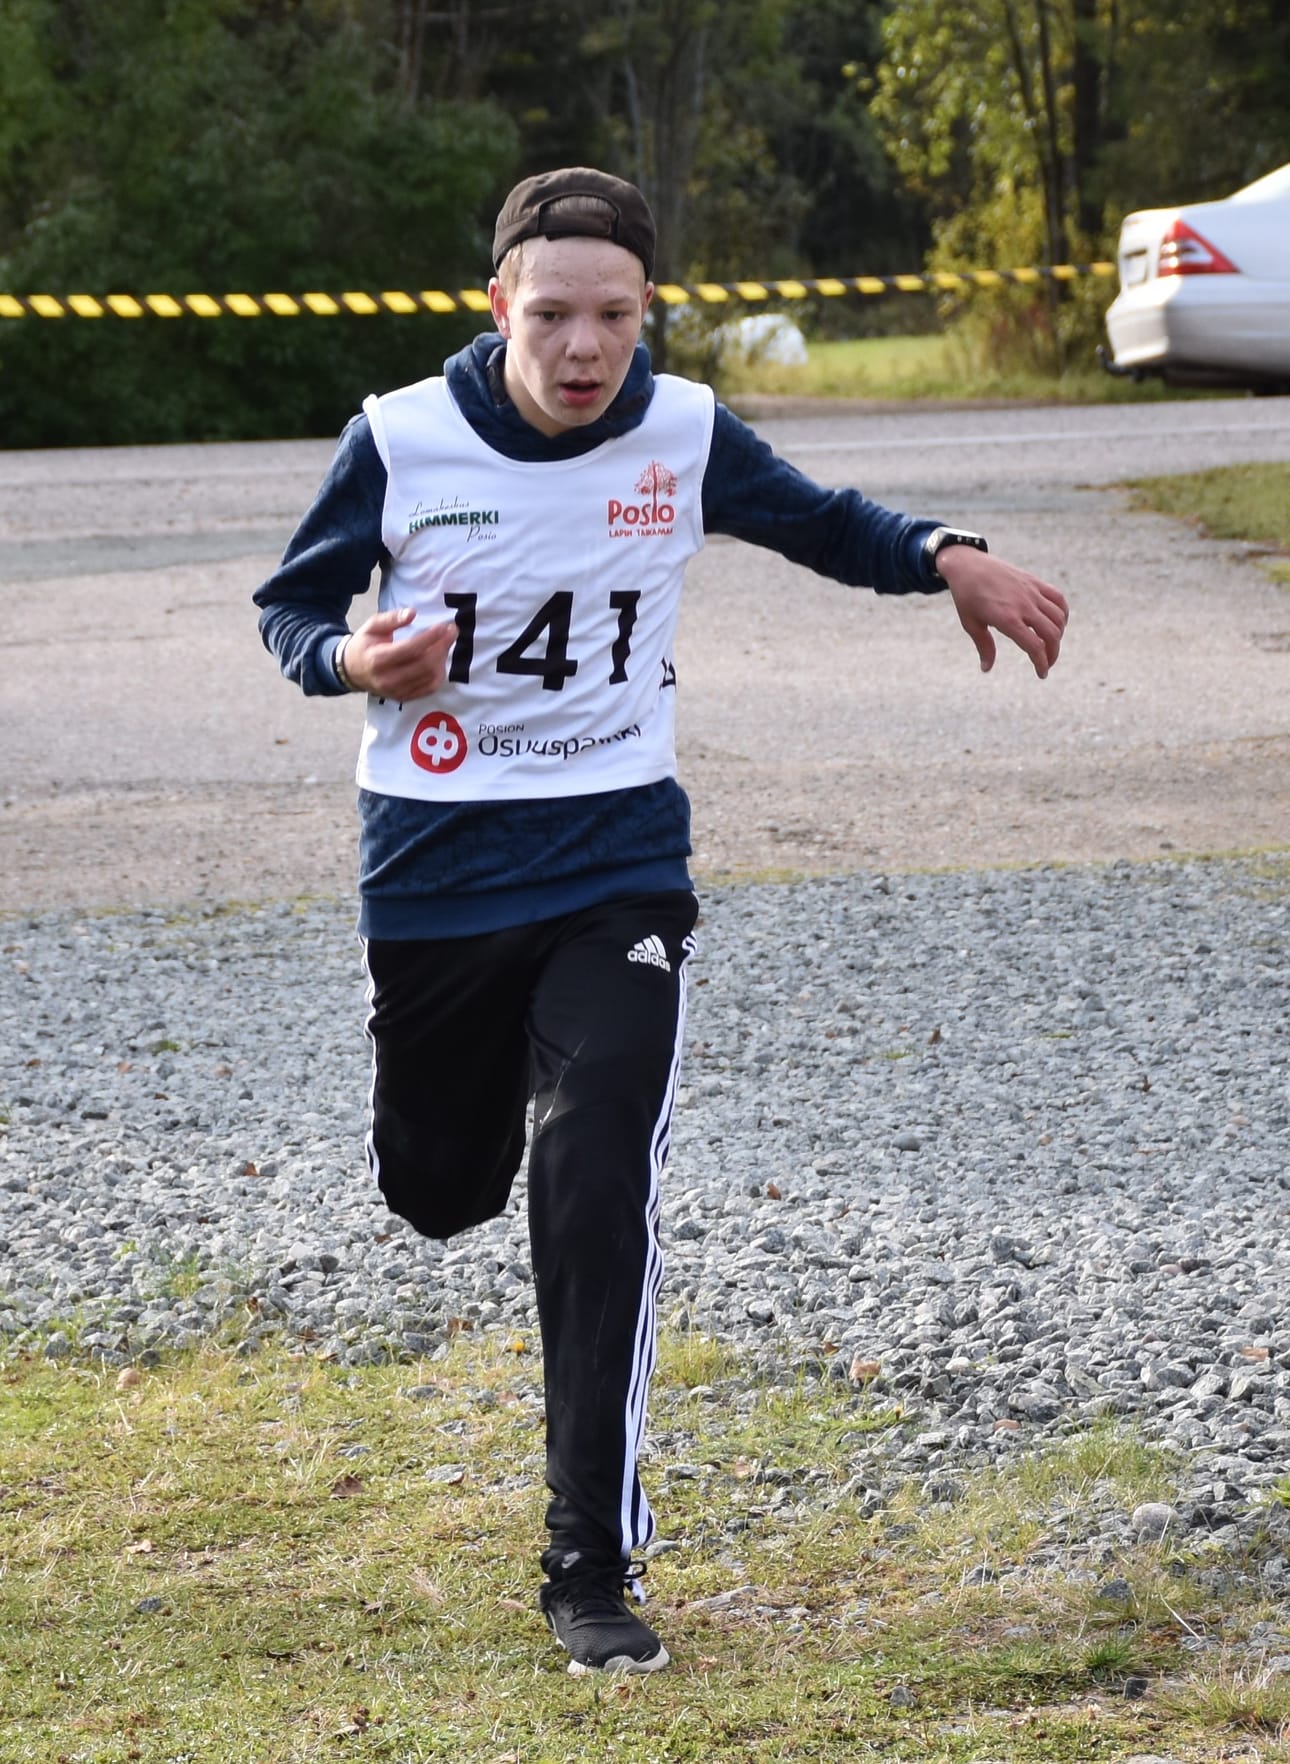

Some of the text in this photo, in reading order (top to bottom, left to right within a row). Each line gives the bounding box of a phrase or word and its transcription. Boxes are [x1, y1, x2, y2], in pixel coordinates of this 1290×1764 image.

[408, 510, 499, 534] HIMMERKI
[608, 530, 633, 538] LAPIN
[444, 590, 641, 691] 141
[478, 723, 525, 735] POSION
[627, 949, 671, 972] adidas
